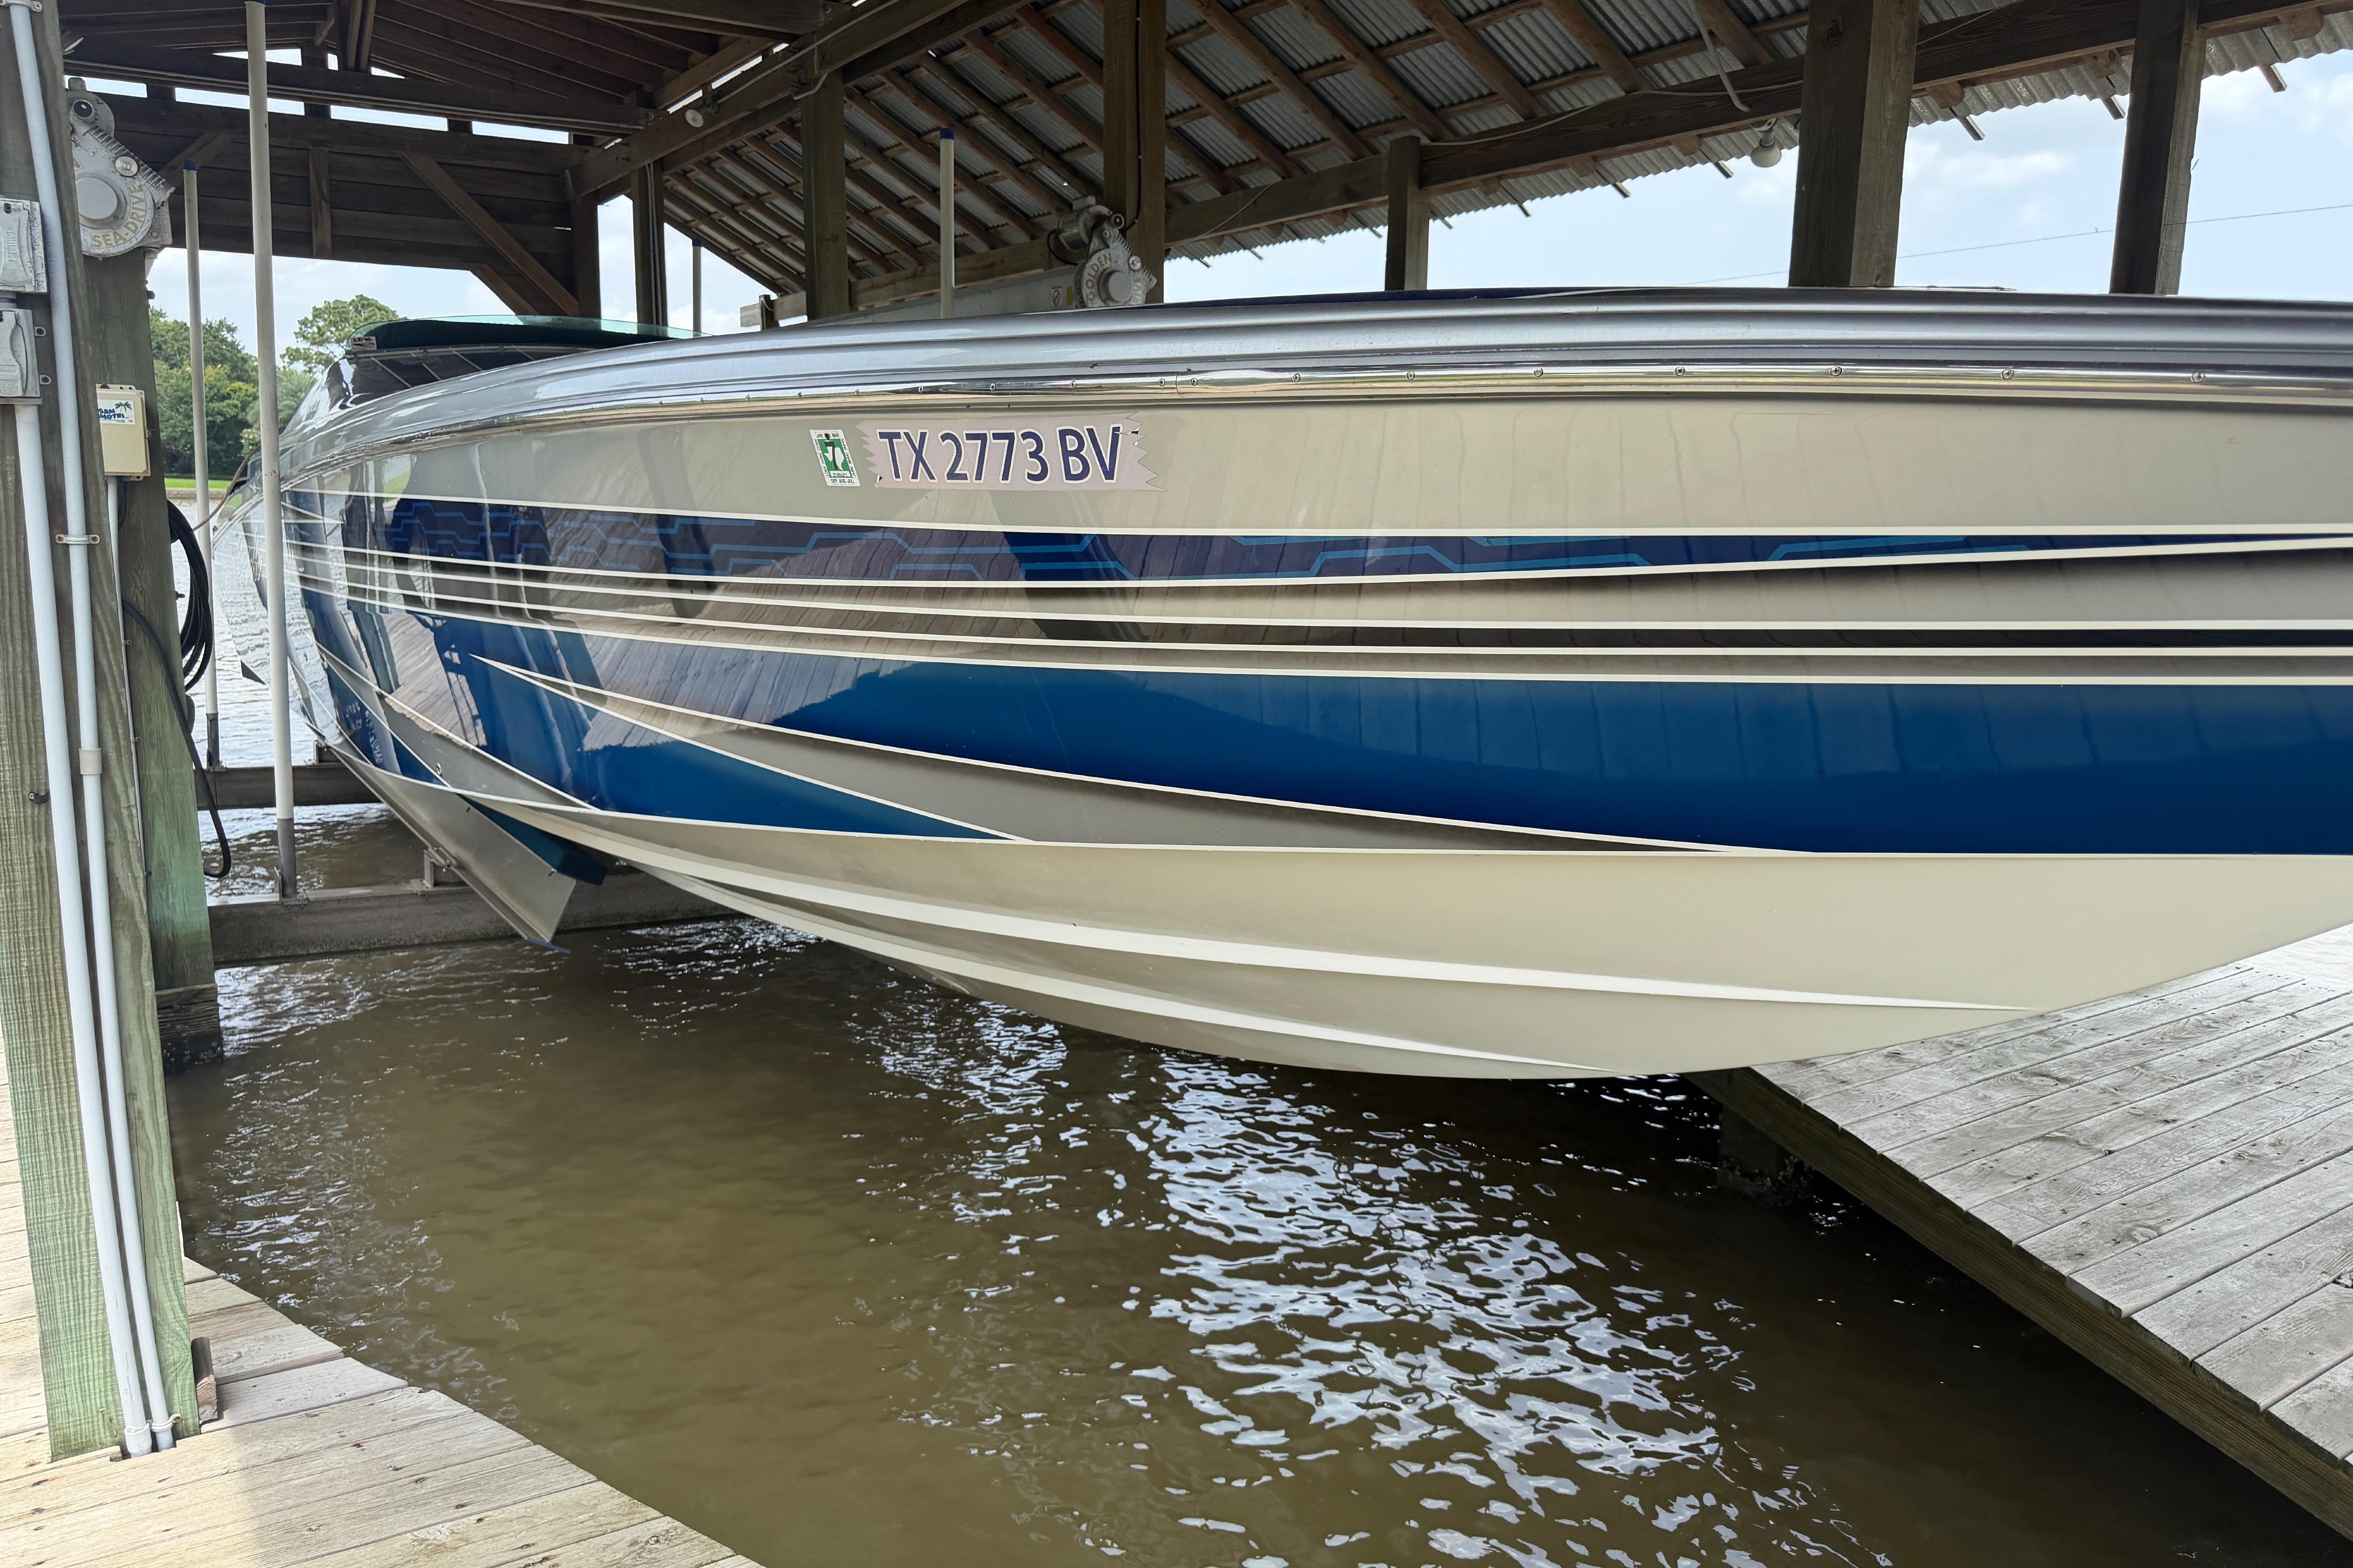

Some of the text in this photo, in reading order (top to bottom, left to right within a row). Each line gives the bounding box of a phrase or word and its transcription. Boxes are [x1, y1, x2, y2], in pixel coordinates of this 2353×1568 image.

[92, 185, 145, 247] SEA-DRIVE
[1086, 253, 1112, 301] GOLDEN
[877, 424, 1123, 484] TX 2773 BV
